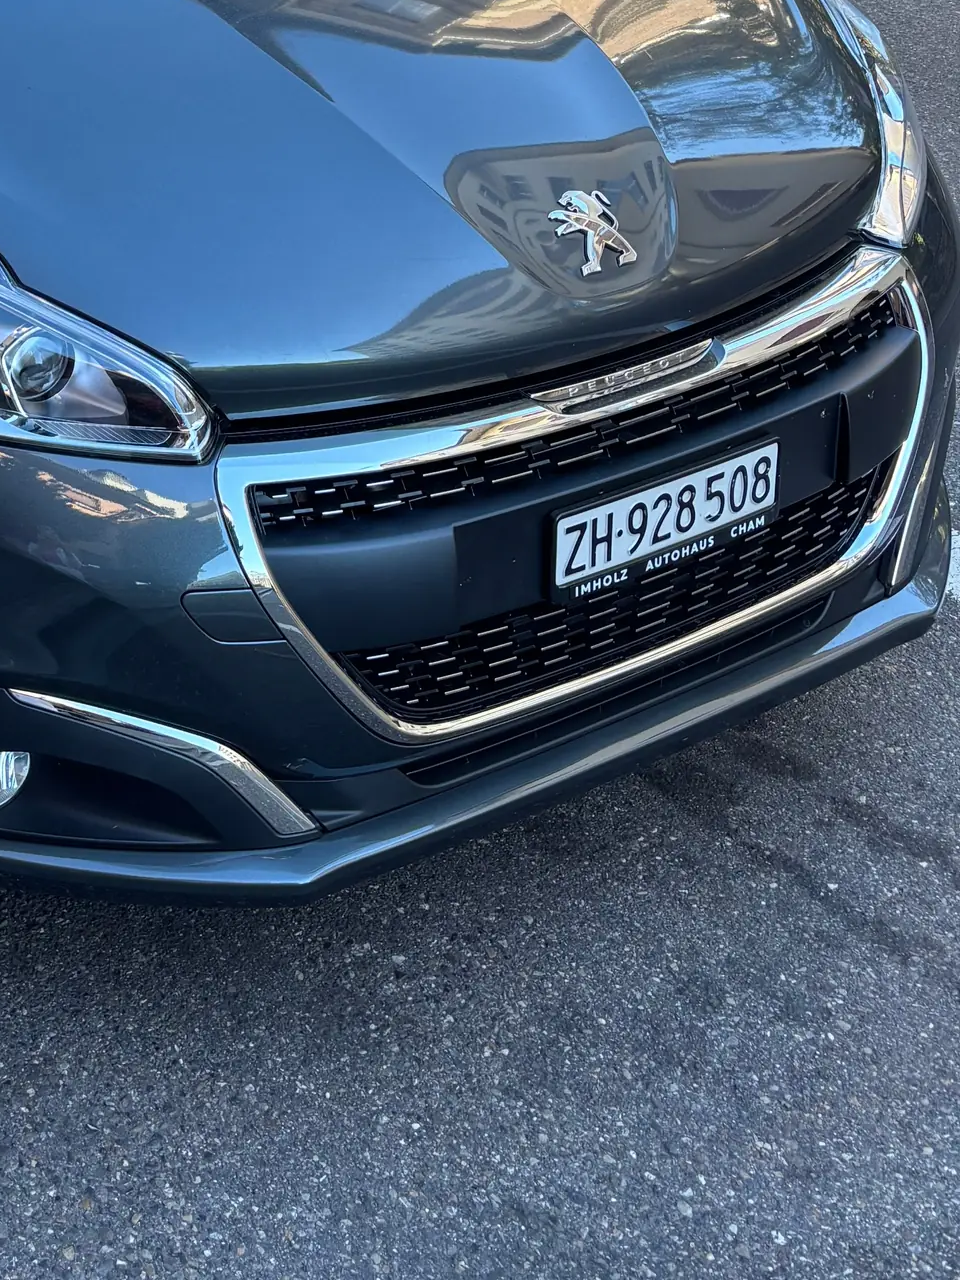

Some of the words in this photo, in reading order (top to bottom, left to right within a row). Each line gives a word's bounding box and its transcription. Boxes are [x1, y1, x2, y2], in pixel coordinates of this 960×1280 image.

[568, 353, 686, 398] PEUGEOT
[575, 569, 628, 597] IMHOLZ
[645, 536, 715, 571] AUTOHAUS
[730, 516, 765, 537] CHAM
